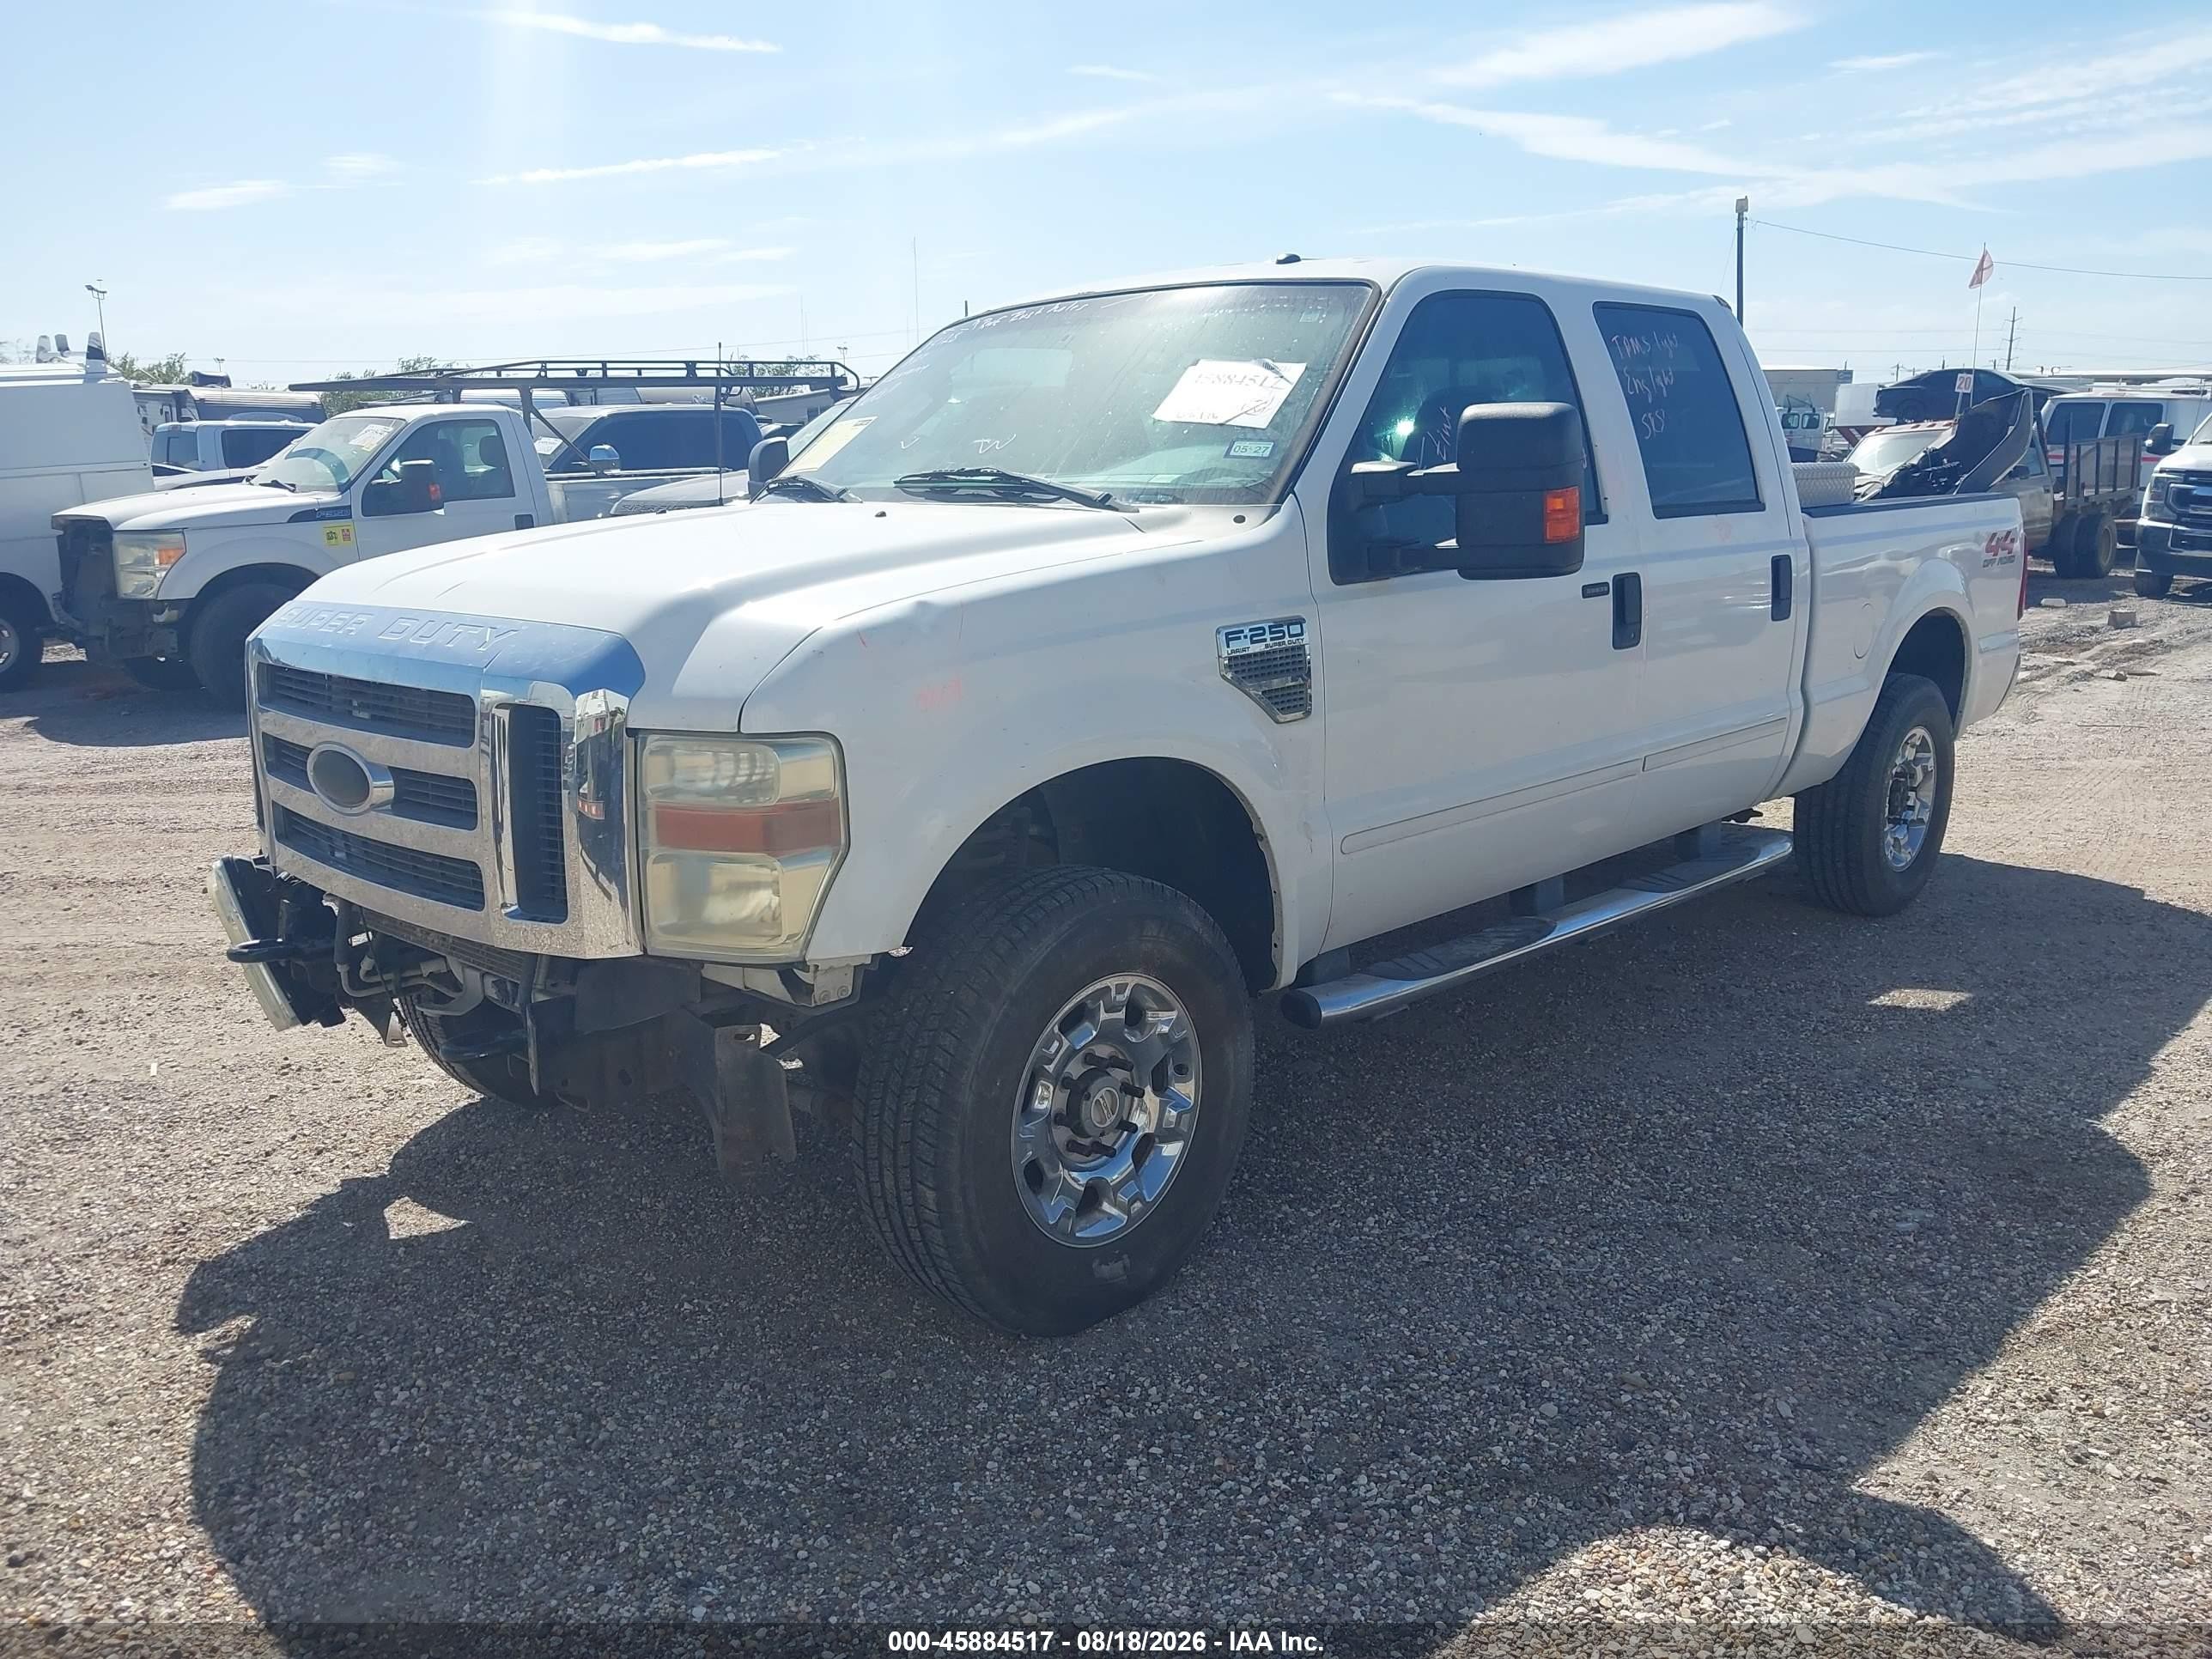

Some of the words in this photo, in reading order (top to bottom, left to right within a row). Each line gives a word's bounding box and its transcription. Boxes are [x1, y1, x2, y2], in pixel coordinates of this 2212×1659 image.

[1957, 376, 1972, 391] 20
[273, 606, 374, 635] SUPER
[378, 616, 519, 652] DUTY
[1224, 621, 1305, 648] F-250
